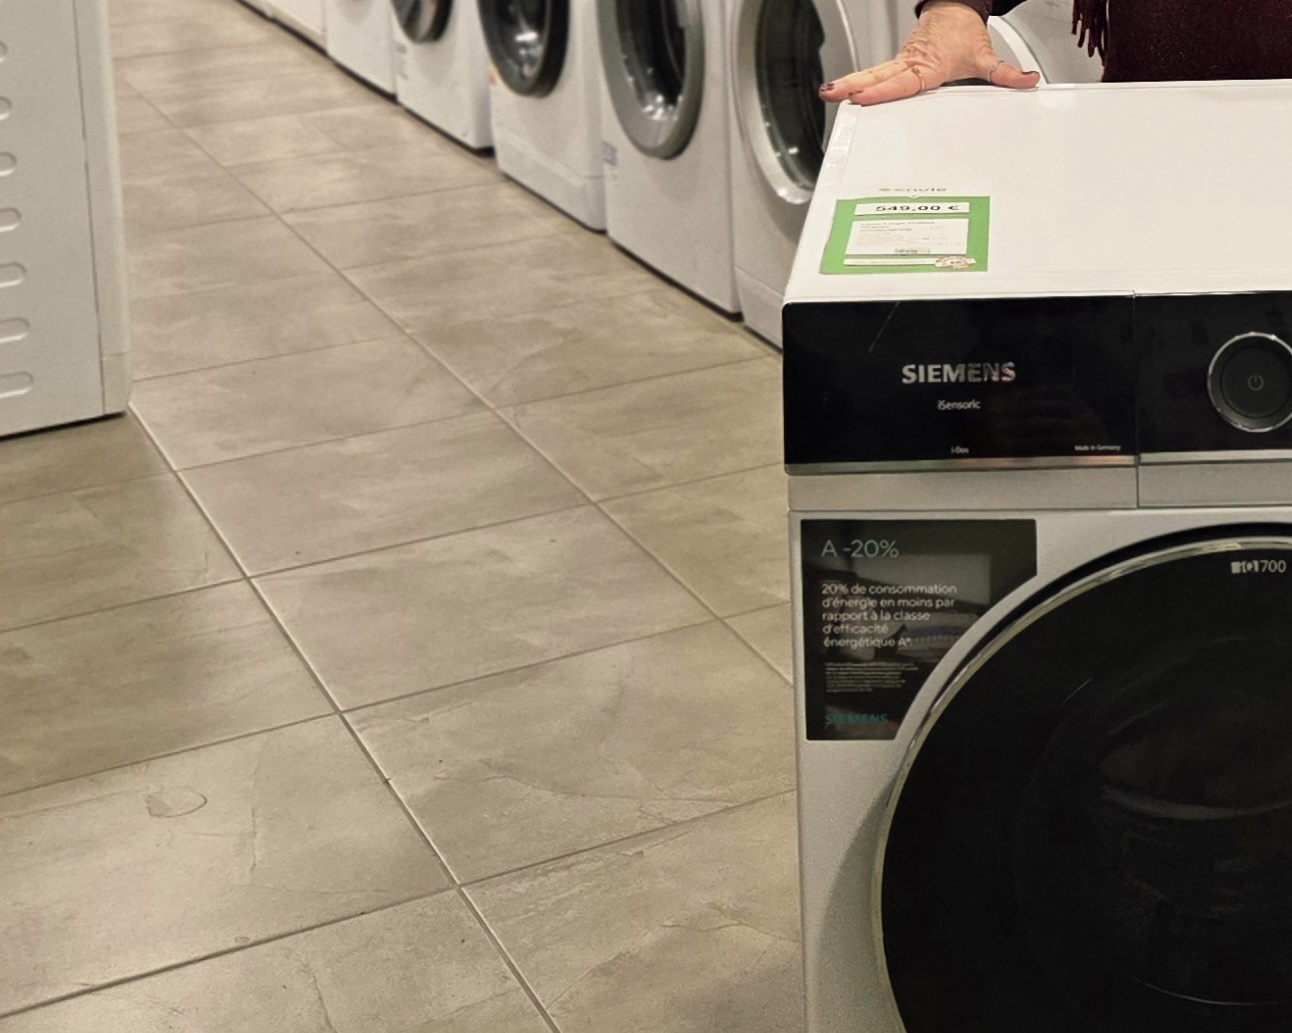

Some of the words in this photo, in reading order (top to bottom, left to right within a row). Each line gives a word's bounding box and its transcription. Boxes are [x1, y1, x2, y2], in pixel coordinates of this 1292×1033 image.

[901, 362, 1017, 385] SIEMENS
[938, 399, 981, 411] iSensoric
[821, 540, 838, 557] A
[842, 539, 900, 558] -20%
[822, 583, 849, 595] 20%
[850, 583, 867, 595] de
[868, 583, 958, 595] consommation
[822, 597, 878, 610] d'énergie
[879, 598, 896, 607] en
[897, 597, 934, 608] moins
[935, 598, 956, 609] par
[822, 610, 869, 622] rapport
[870, 610, 878, 621] à
[880, 610, 892, 621] la
[893, 610, 931, 621] classe
[822, 622, 890, 635] d'efficacité
[823, 637, 896, 650] énergétique
